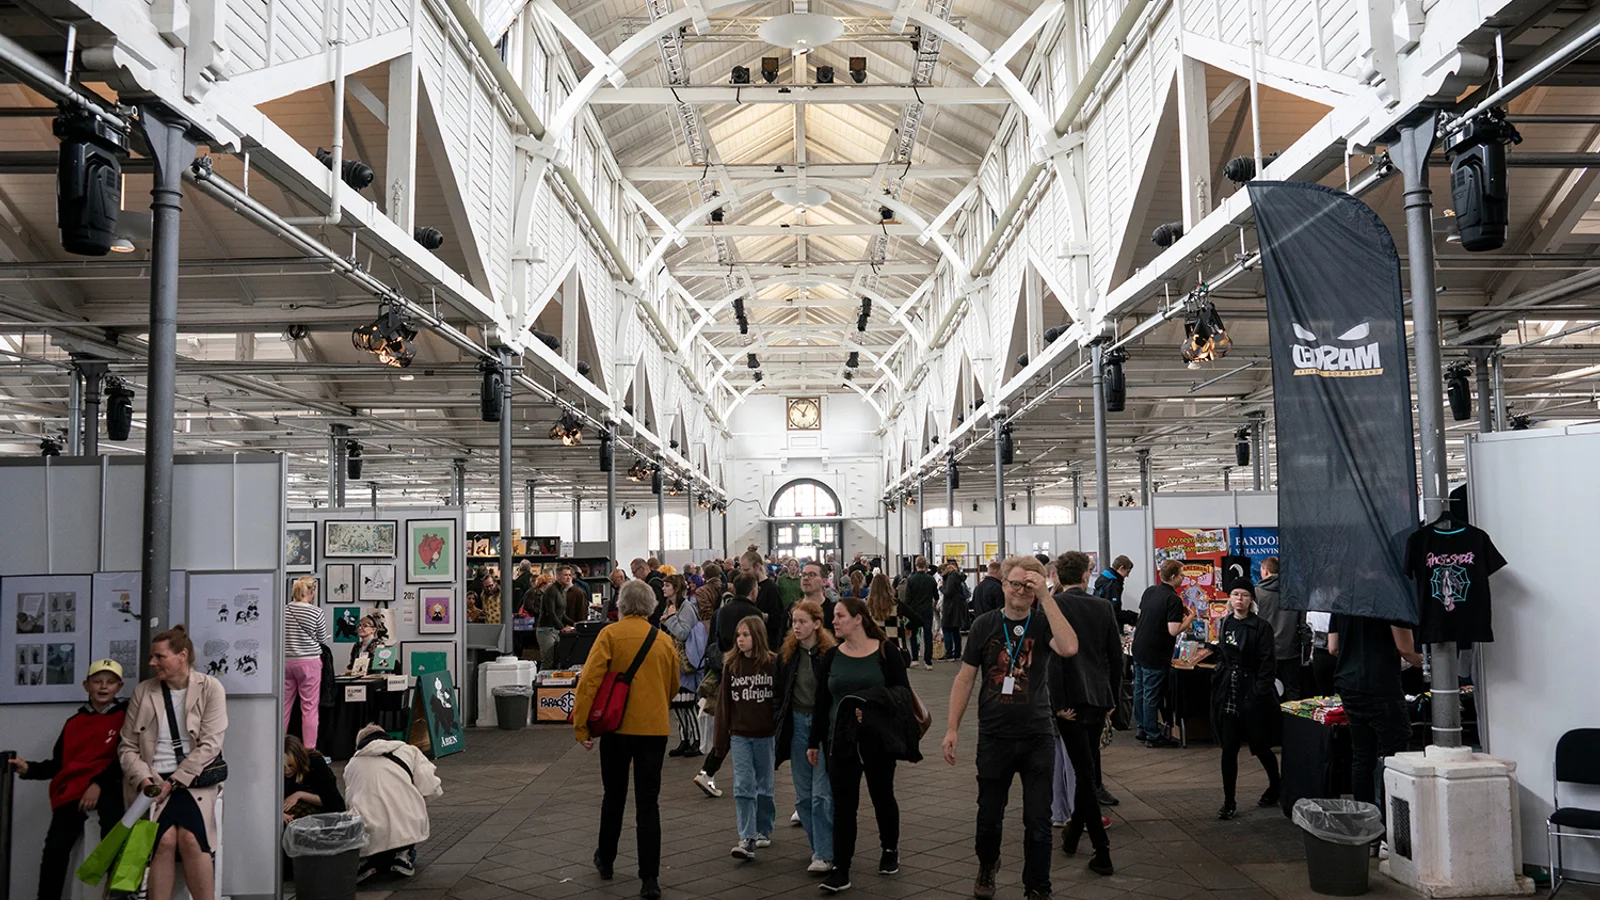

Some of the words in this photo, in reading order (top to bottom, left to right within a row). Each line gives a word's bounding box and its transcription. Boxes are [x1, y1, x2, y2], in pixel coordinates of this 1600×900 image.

[1235, 547, 1279, 555] VLKANVIN
[731, 673, 773, 689] Everythin
[742, 687, 773, 703] Alrigh
